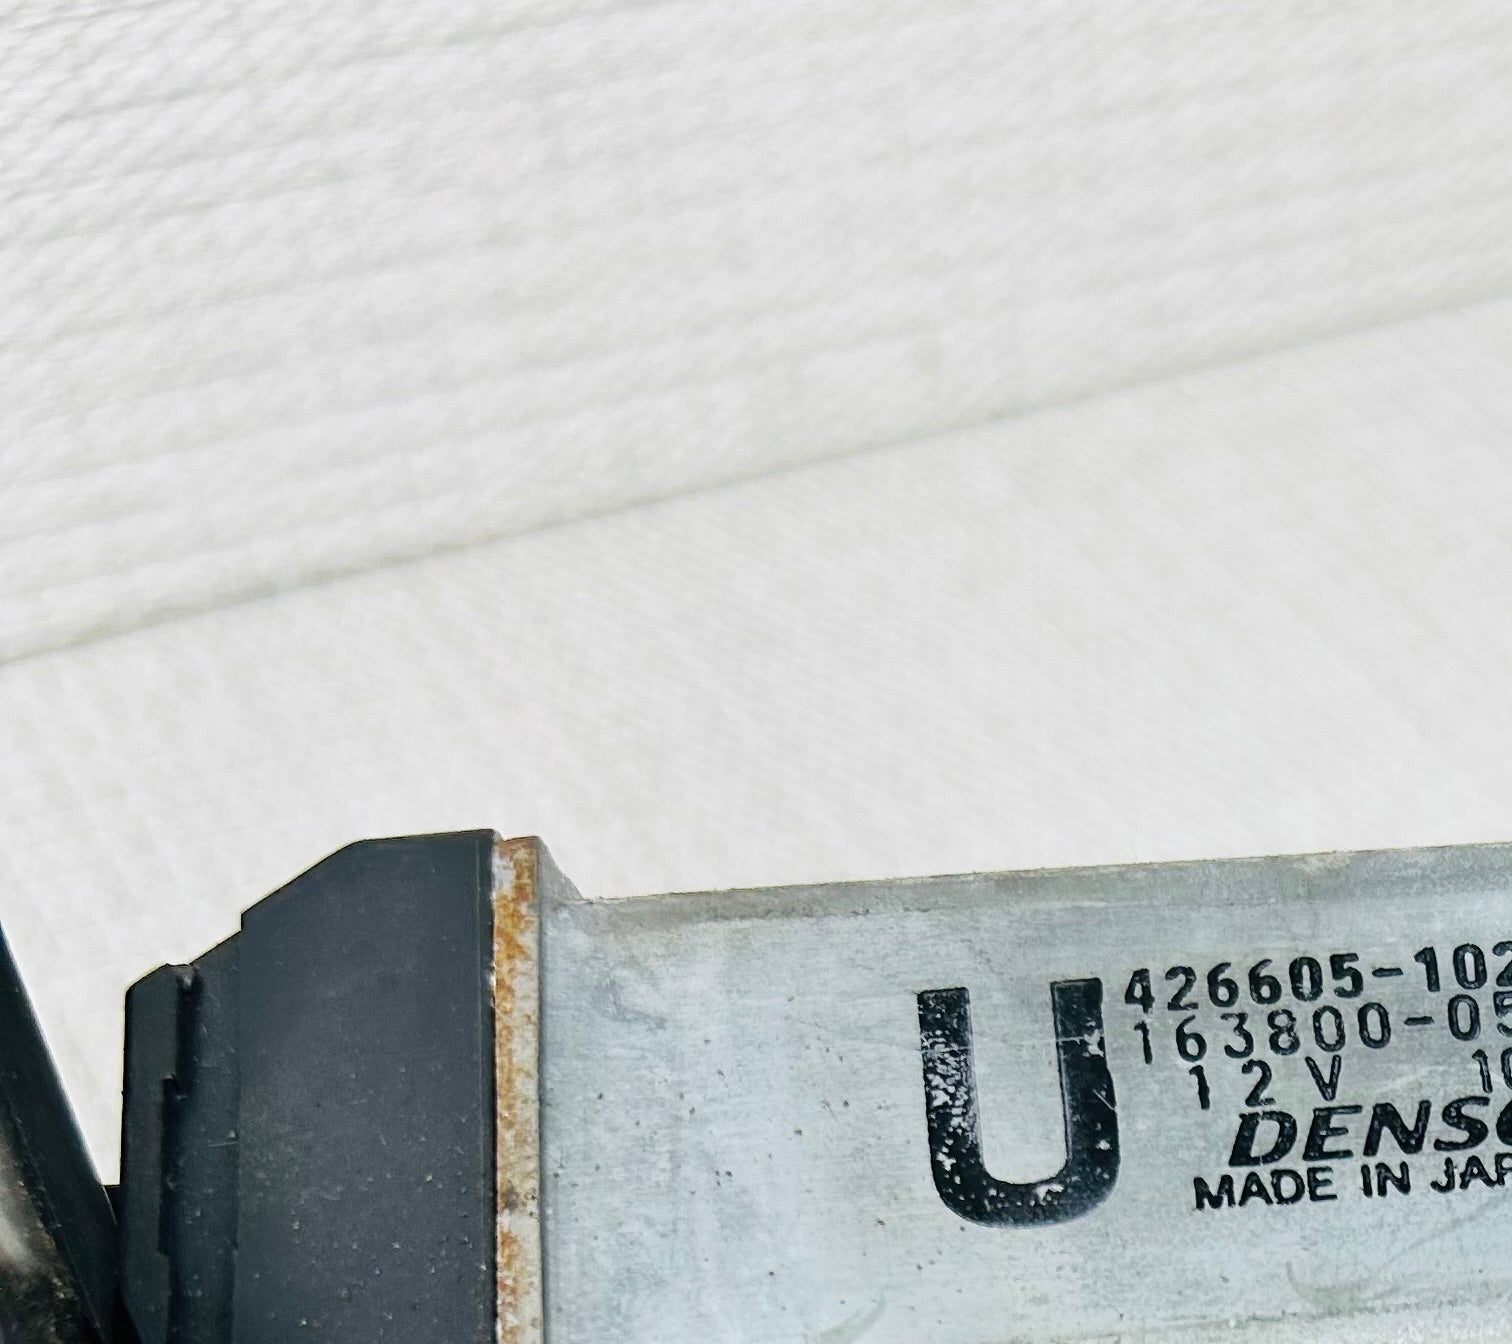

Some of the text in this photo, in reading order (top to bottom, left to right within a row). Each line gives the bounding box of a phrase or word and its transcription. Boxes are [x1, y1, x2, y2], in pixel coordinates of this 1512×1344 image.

[916, 976, 1121, 1229] U
[1193, 1166, 1339, 1210] MADE
[1362, 1161, 1411, 1199] IN
